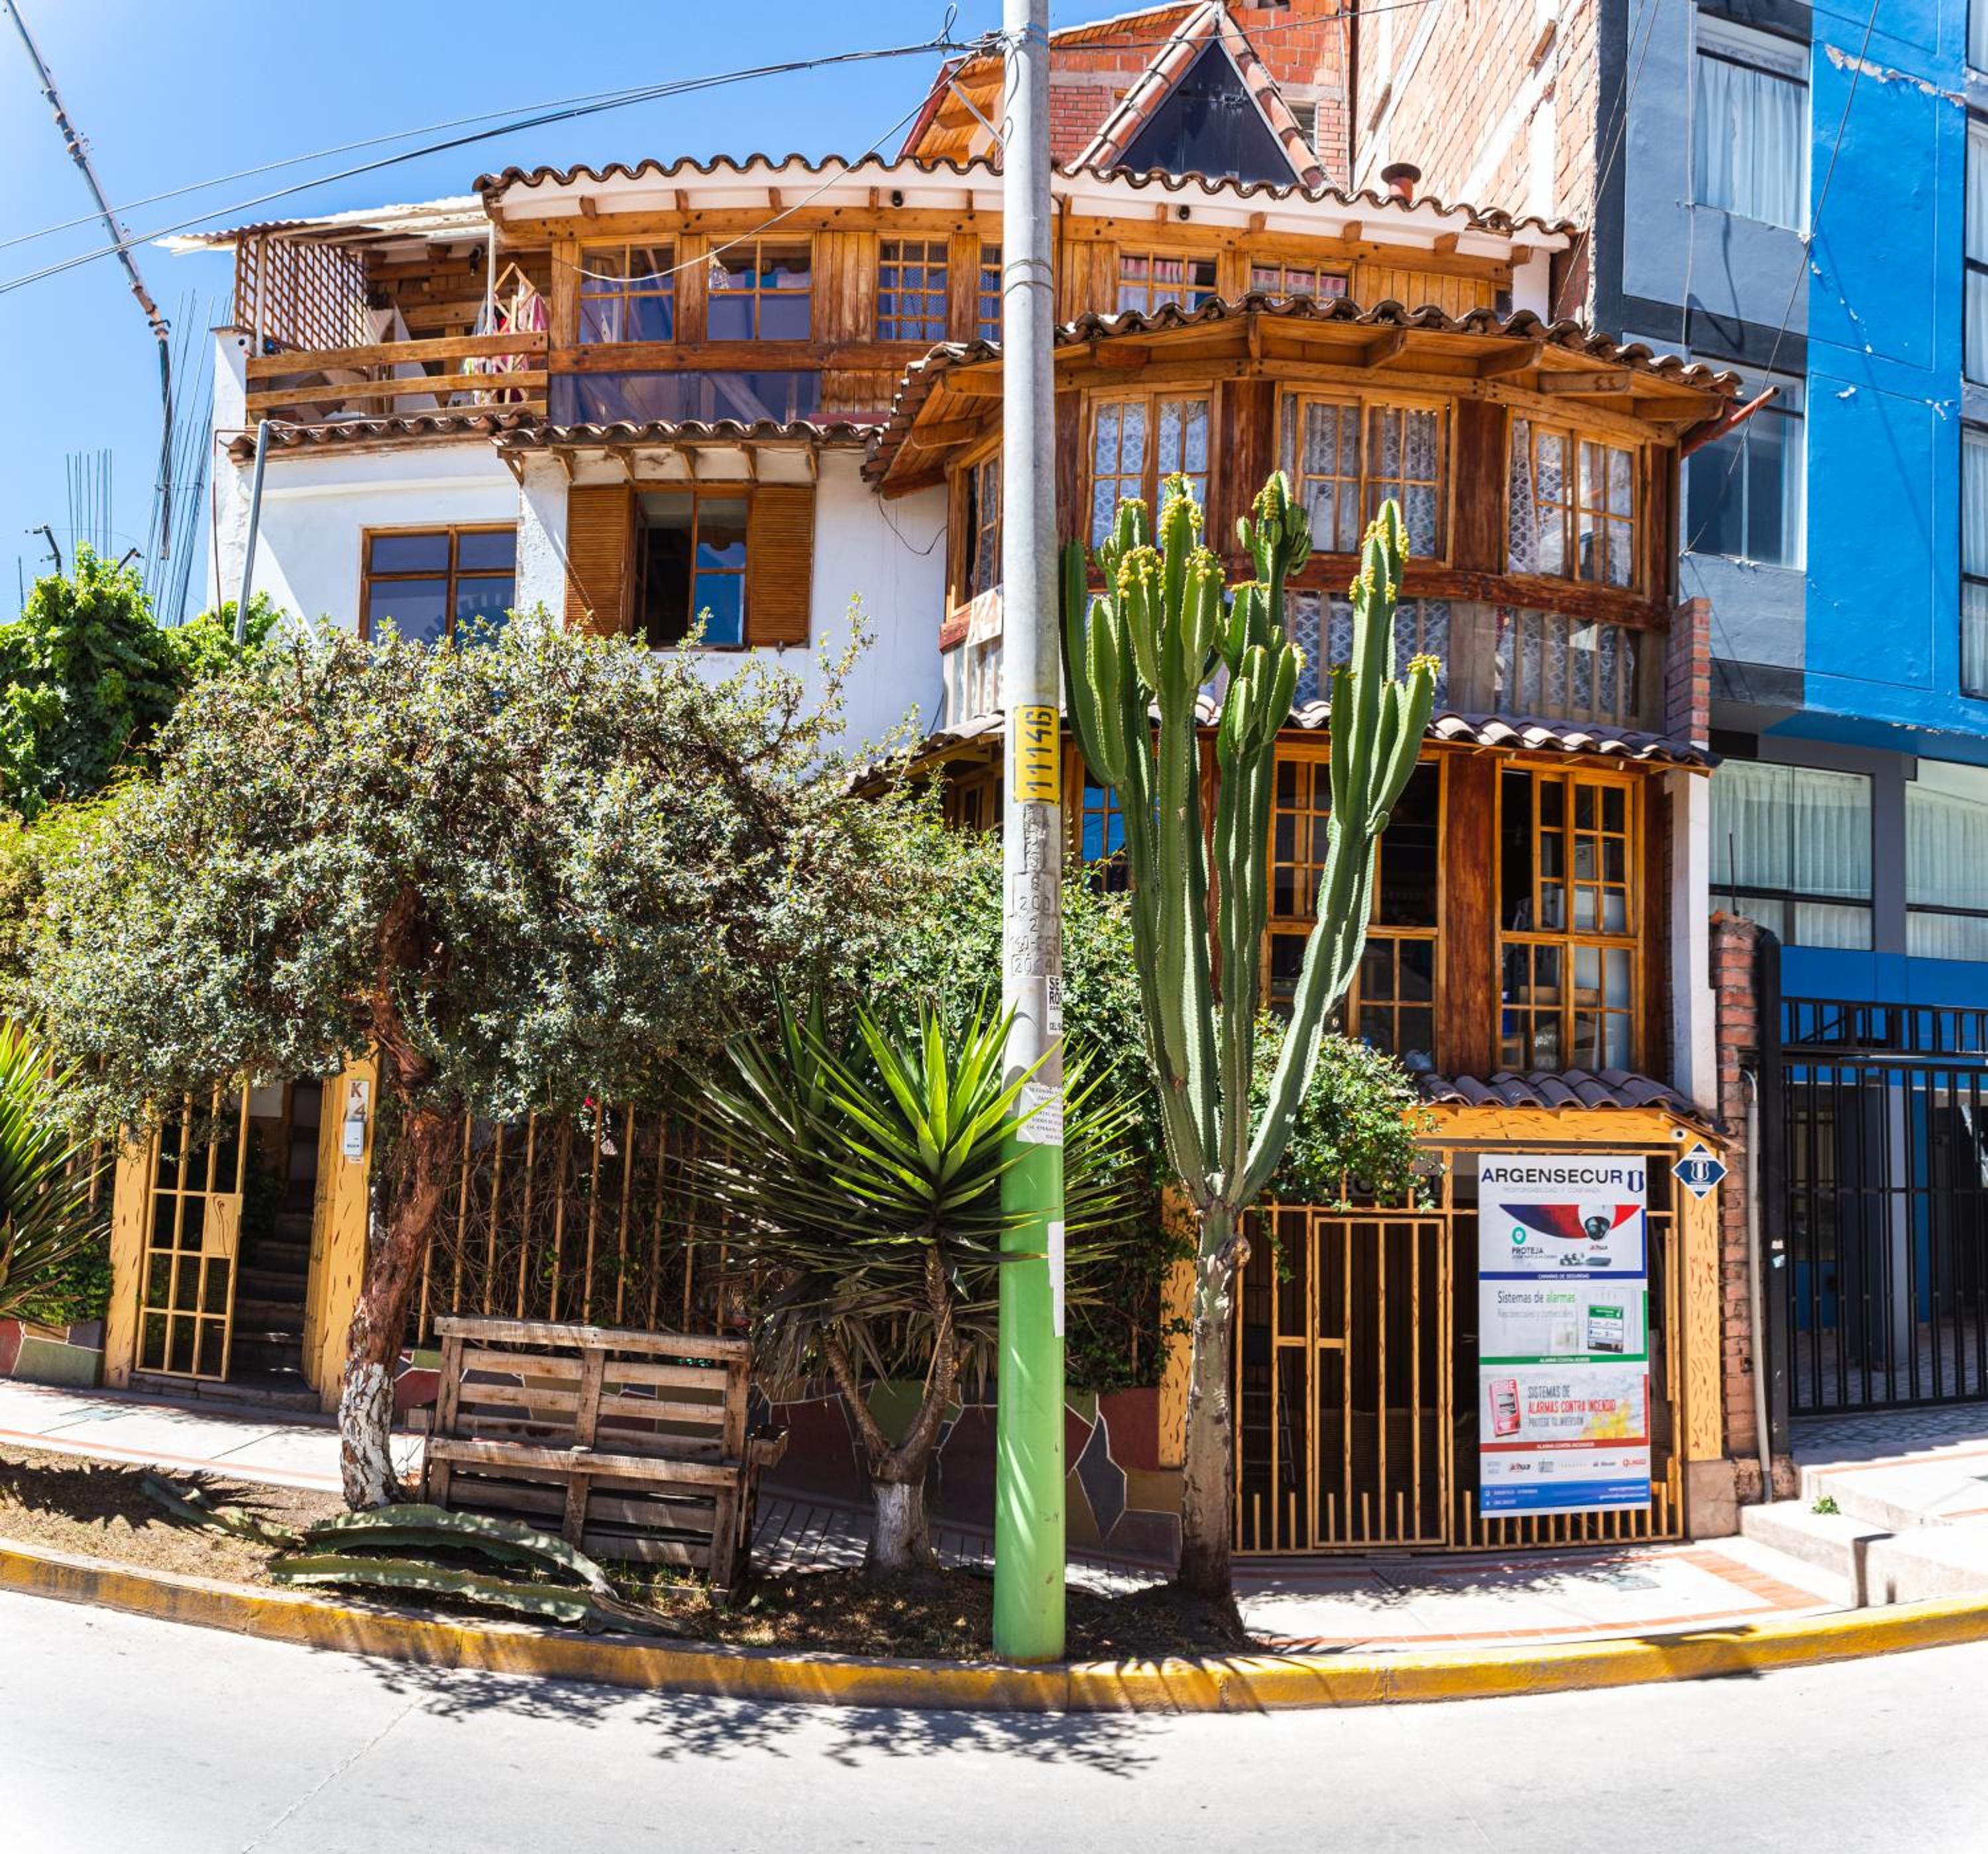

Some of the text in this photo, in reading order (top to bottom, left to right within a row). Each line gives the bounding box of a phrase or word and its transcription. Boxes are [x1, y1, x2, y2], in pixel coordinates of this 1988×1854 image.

[351, 1082, 362, 1098] K
[354, 1103, 366, 1121] 4
[1481, 1168, 1623, 1184] ARGENSECUR
[1497, 1290, 1576, 1303] Sistemas de alarmas
[1527, 1385, 1570, 1399] SISTEMAS DE
[1528, 1399, 1616, 1414] ALARMAS CONTRA INCENDIO
